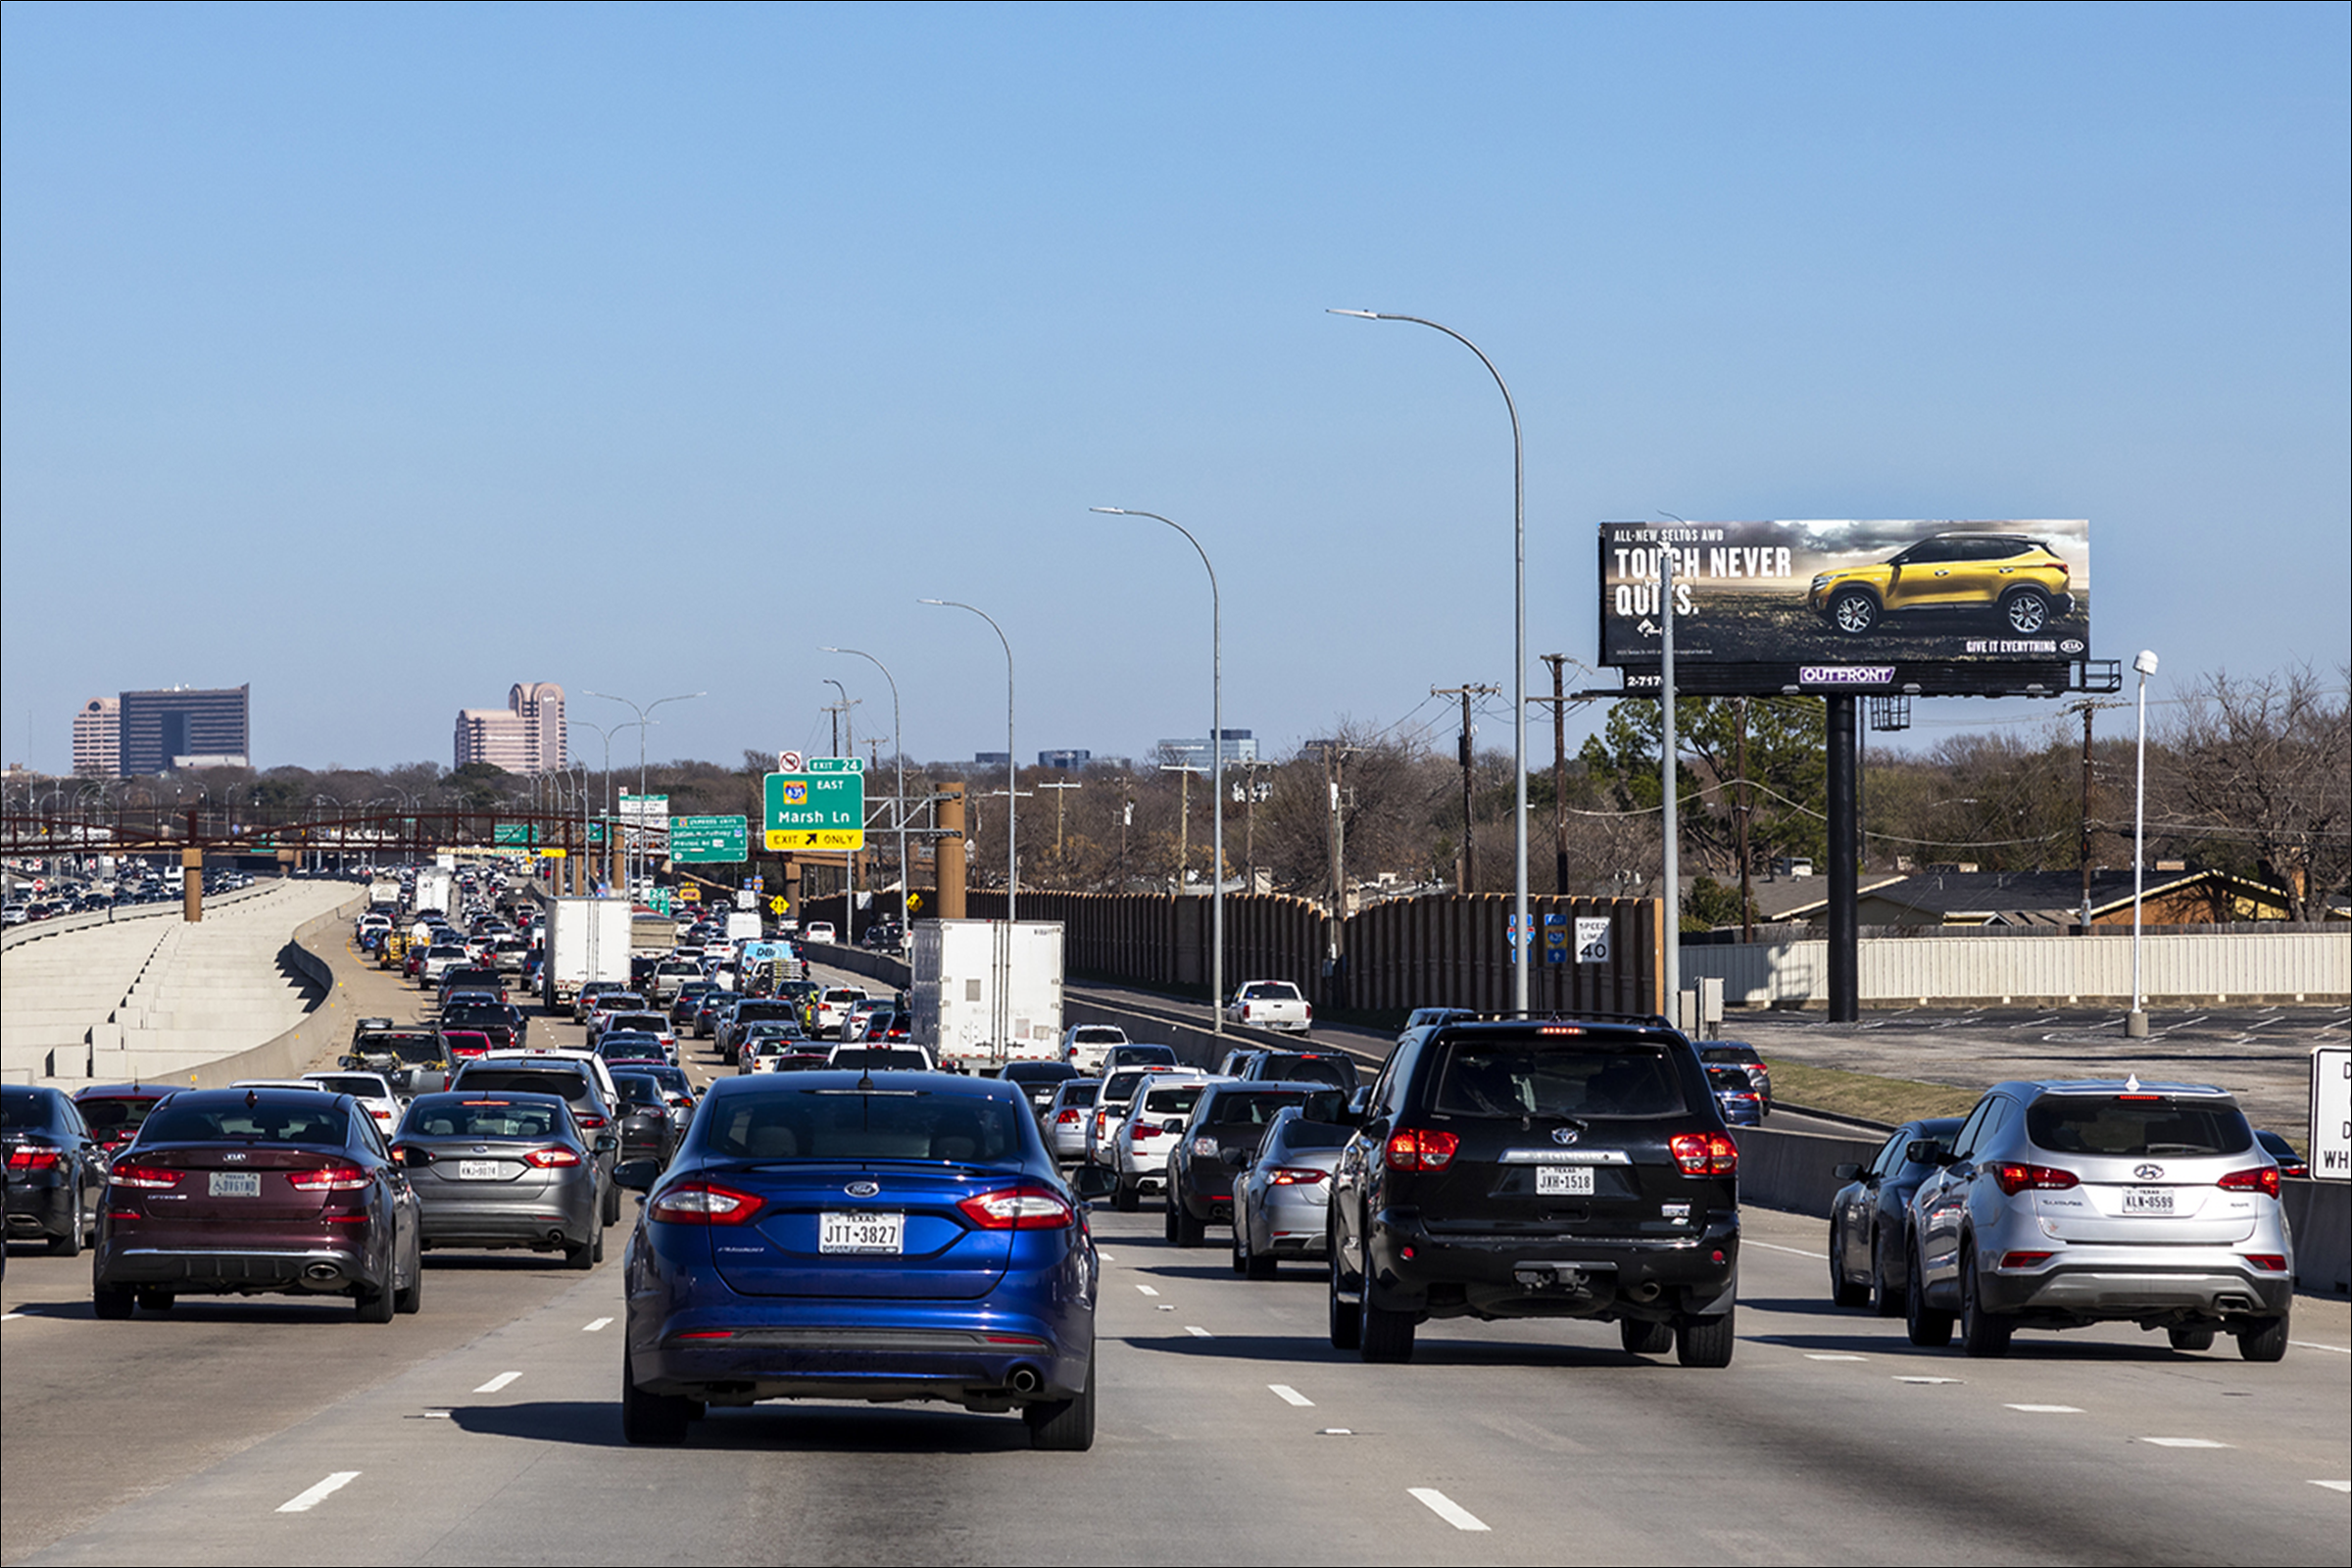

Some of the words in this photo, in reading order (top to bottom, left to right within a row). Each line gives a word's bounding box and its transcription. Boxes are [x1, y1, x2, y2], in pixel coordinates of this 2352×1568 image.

[1614, 529, 1657, 542] ALL-NEW
[1661, 529, 1697, 542] SELTOS
[1701, 529, 1723, 541] AWD
[1710, 547, 1791, 578] NEVER
[1615, 584, 1699, 616] QUIS.
[1966, 640, 1987, 653] GIVE
[1988, 640, 1998, 653] IT
[2000, 640, 2056, 653] EVERYTHING
[1628, 676, 1663, 686] 2-717
[1803, 667, 1889, 682] OUTFRONT
[842, 760, 858, 771] 24
[816, 780, 844, 790] EAST
[778, 810, 823, 823] Marsh
[832, 811, 850, 823] Ln
[773, 835, 798, 844] EXIT
[823, 834, 854, 844] ONLY
[651, 888, 666, 900] 24
[1580, 943, 1606, 958] 40
[2324, 1151, 2351, 1169] WH
